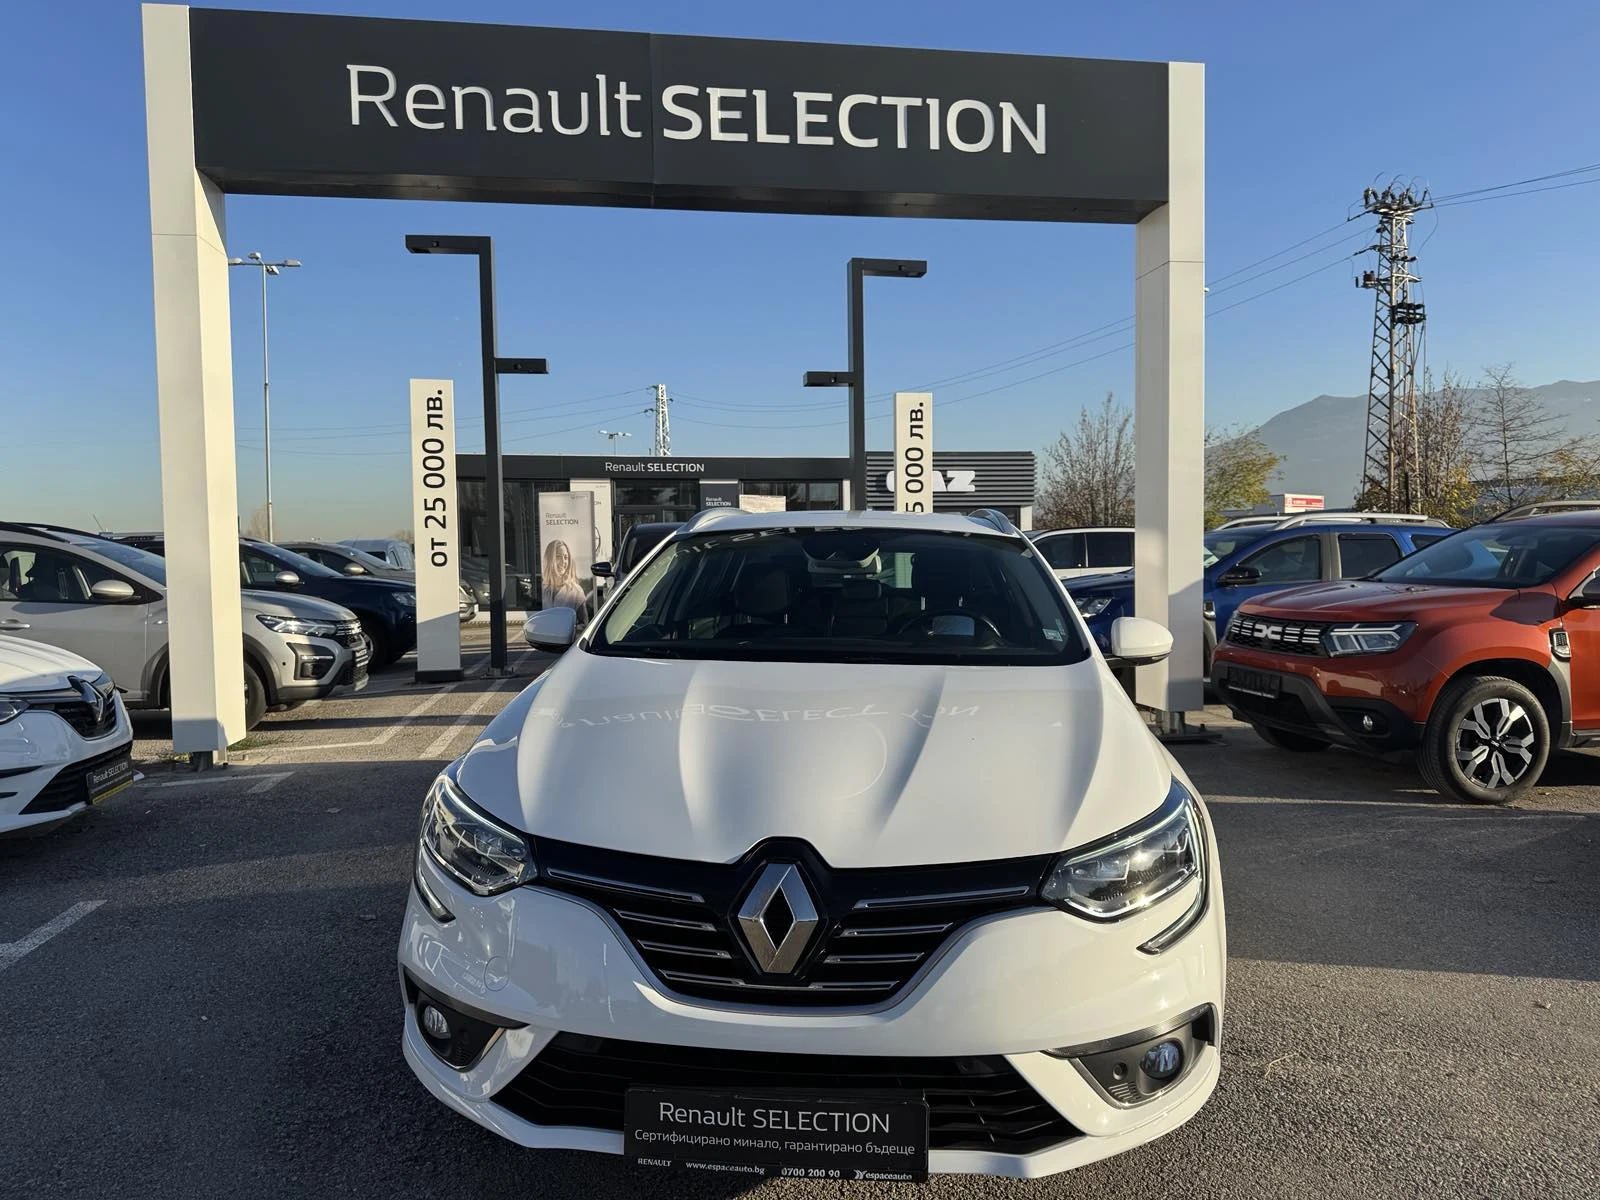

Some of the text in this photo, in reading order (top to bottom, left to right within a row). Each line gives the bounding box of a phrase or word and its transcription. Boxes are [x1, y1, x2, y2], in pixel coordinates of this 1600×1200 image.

[346, 64, 1047, 155] Renault SELECTION
[909, 402, 924, 440] лв.
[421, 389, 448, 567] от 25 000 лв.
[605, 462, 705, 473] Renault SELECTION
[904, 446, 924, 494] 000
[659, 1101, 890, 1134] Renault SELECTION
[634, 1129, 915, 1156] Сертифицирано минало, гарантирано бъдеще
[637, 1157, 672, 1167] RENAULT
[685, 1161, 766, 1175] www.espaceauto.bg
[781, 1167, 841, 1179] 0700 200 90
[865, 1172, 913, 1181] espaceauto
